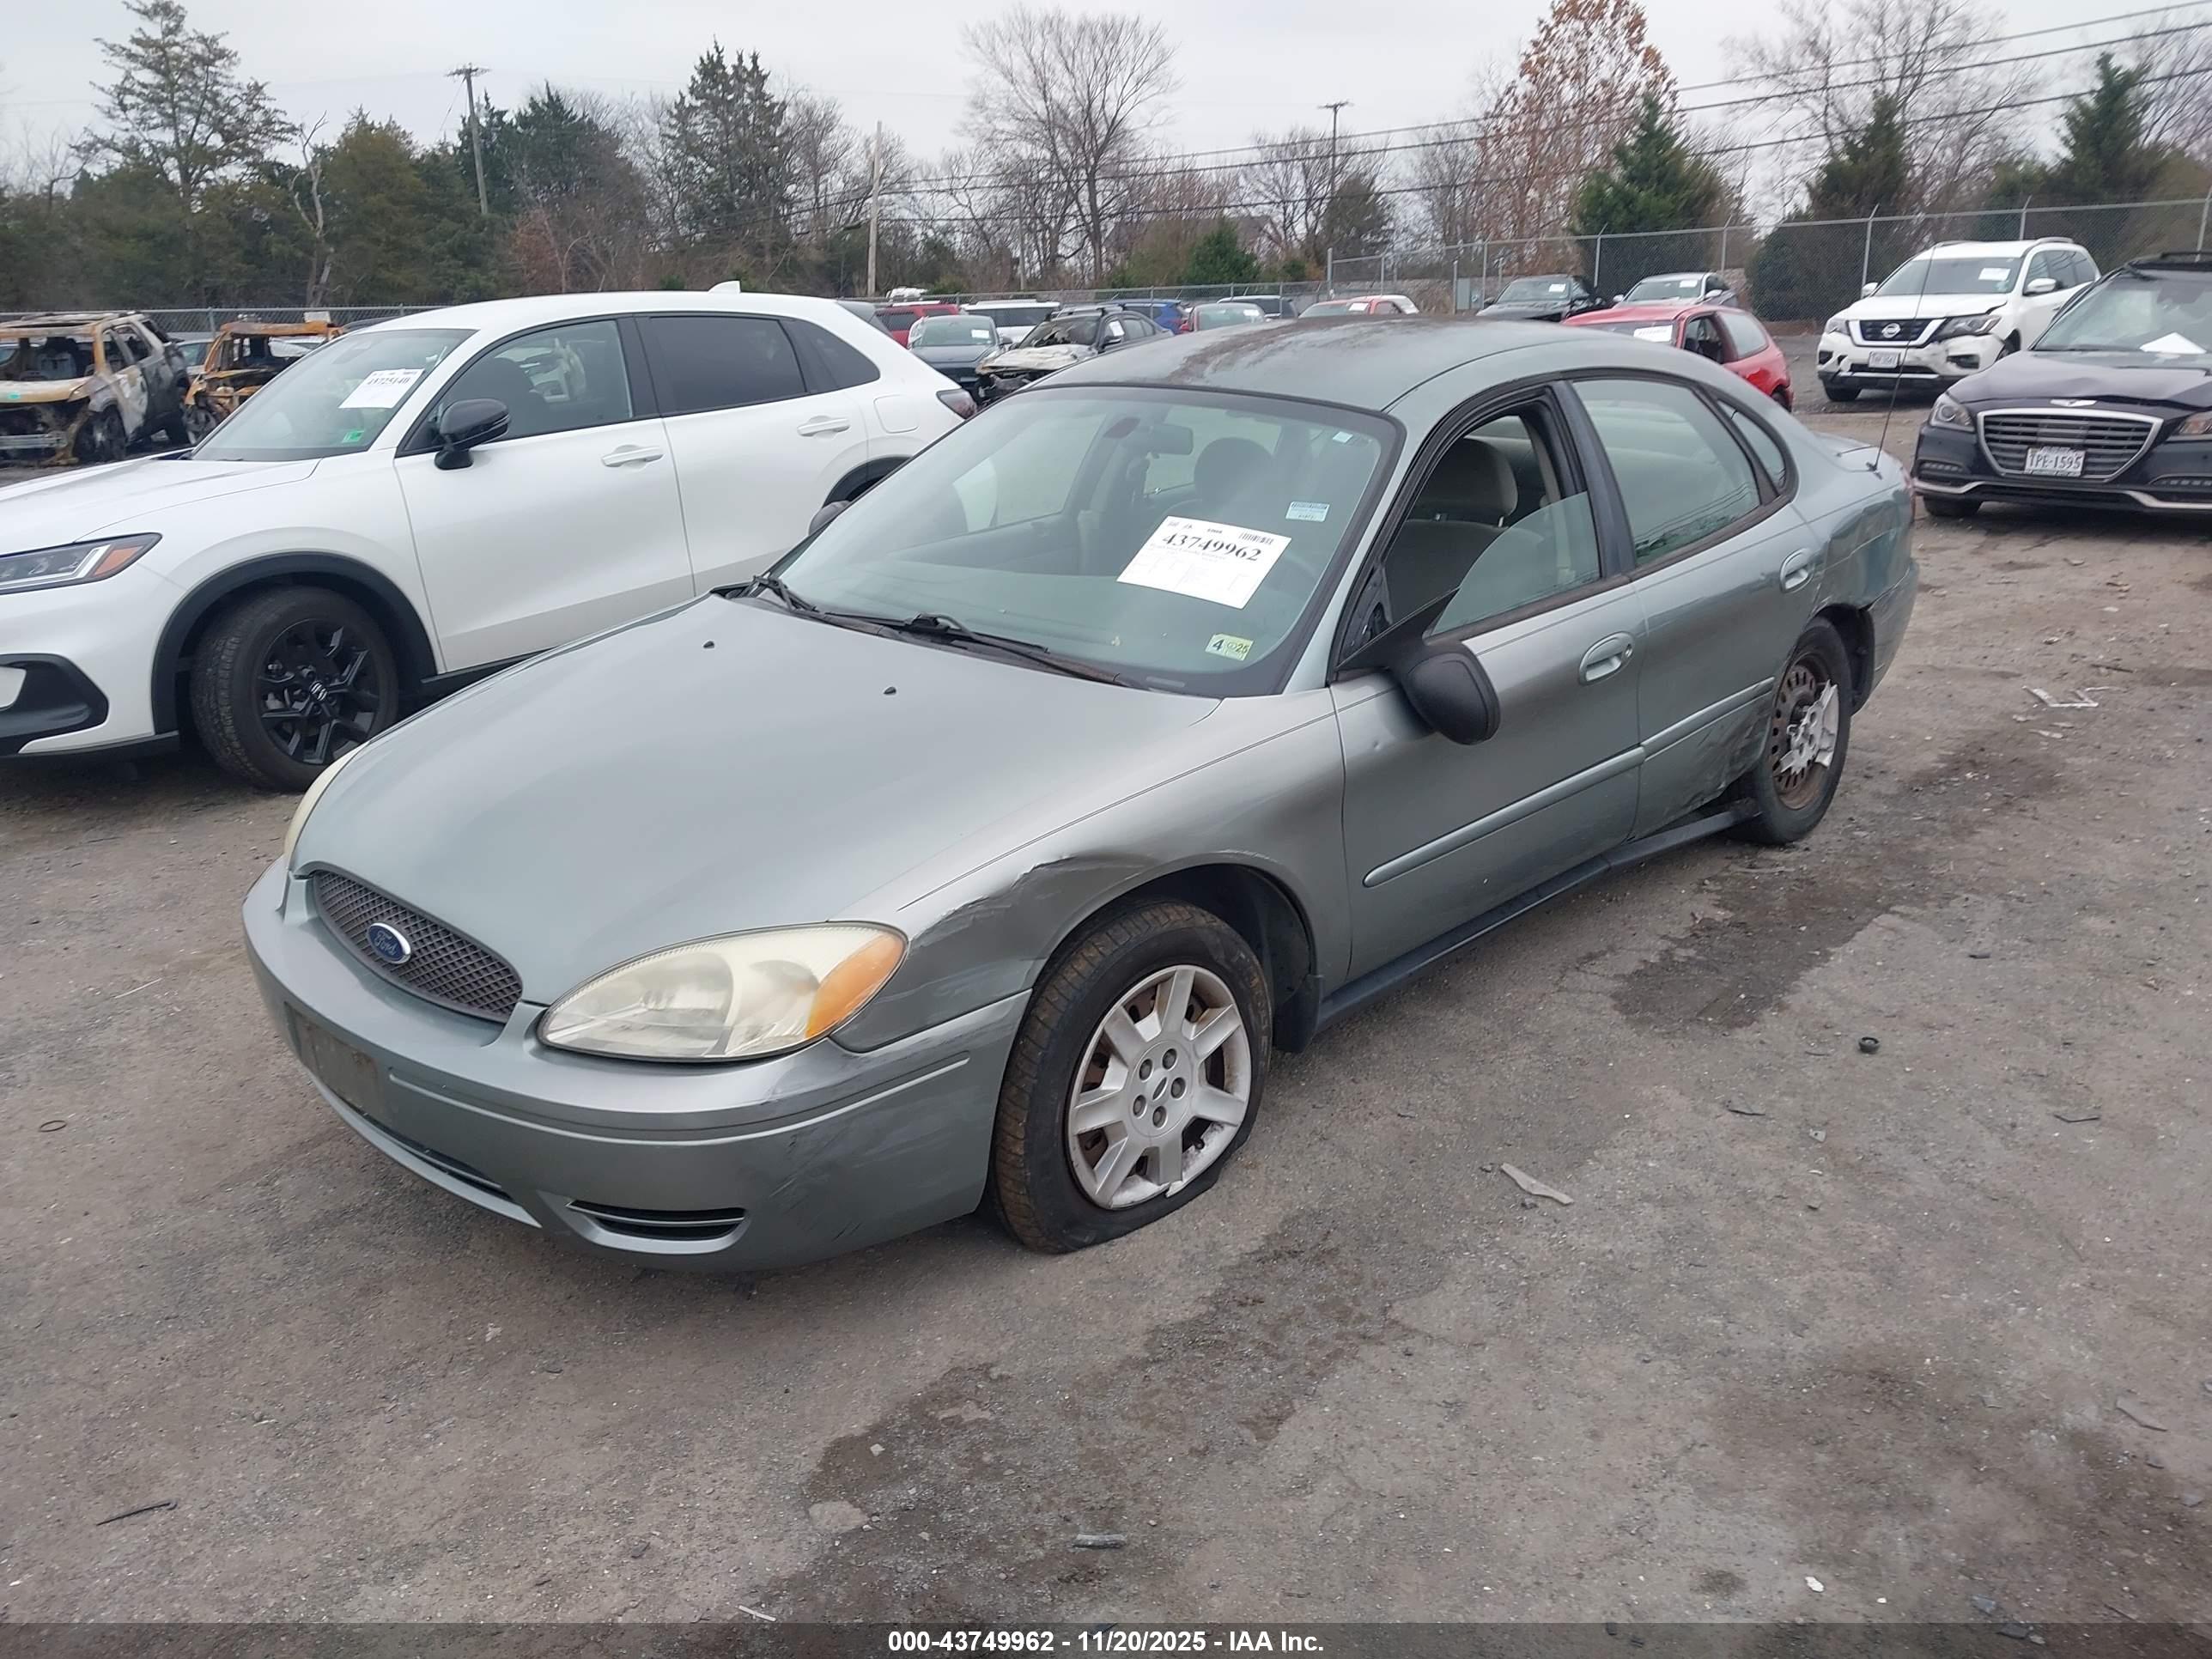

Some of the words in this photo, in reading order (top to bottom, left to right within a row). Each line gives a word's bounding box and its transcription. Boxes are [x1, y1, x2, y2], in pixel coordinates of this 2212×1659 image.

[1163, 532, 1262, 562] 43749962
[1212, 639, 1225, 651] 4
[373, 929, 399, 957] Ford
